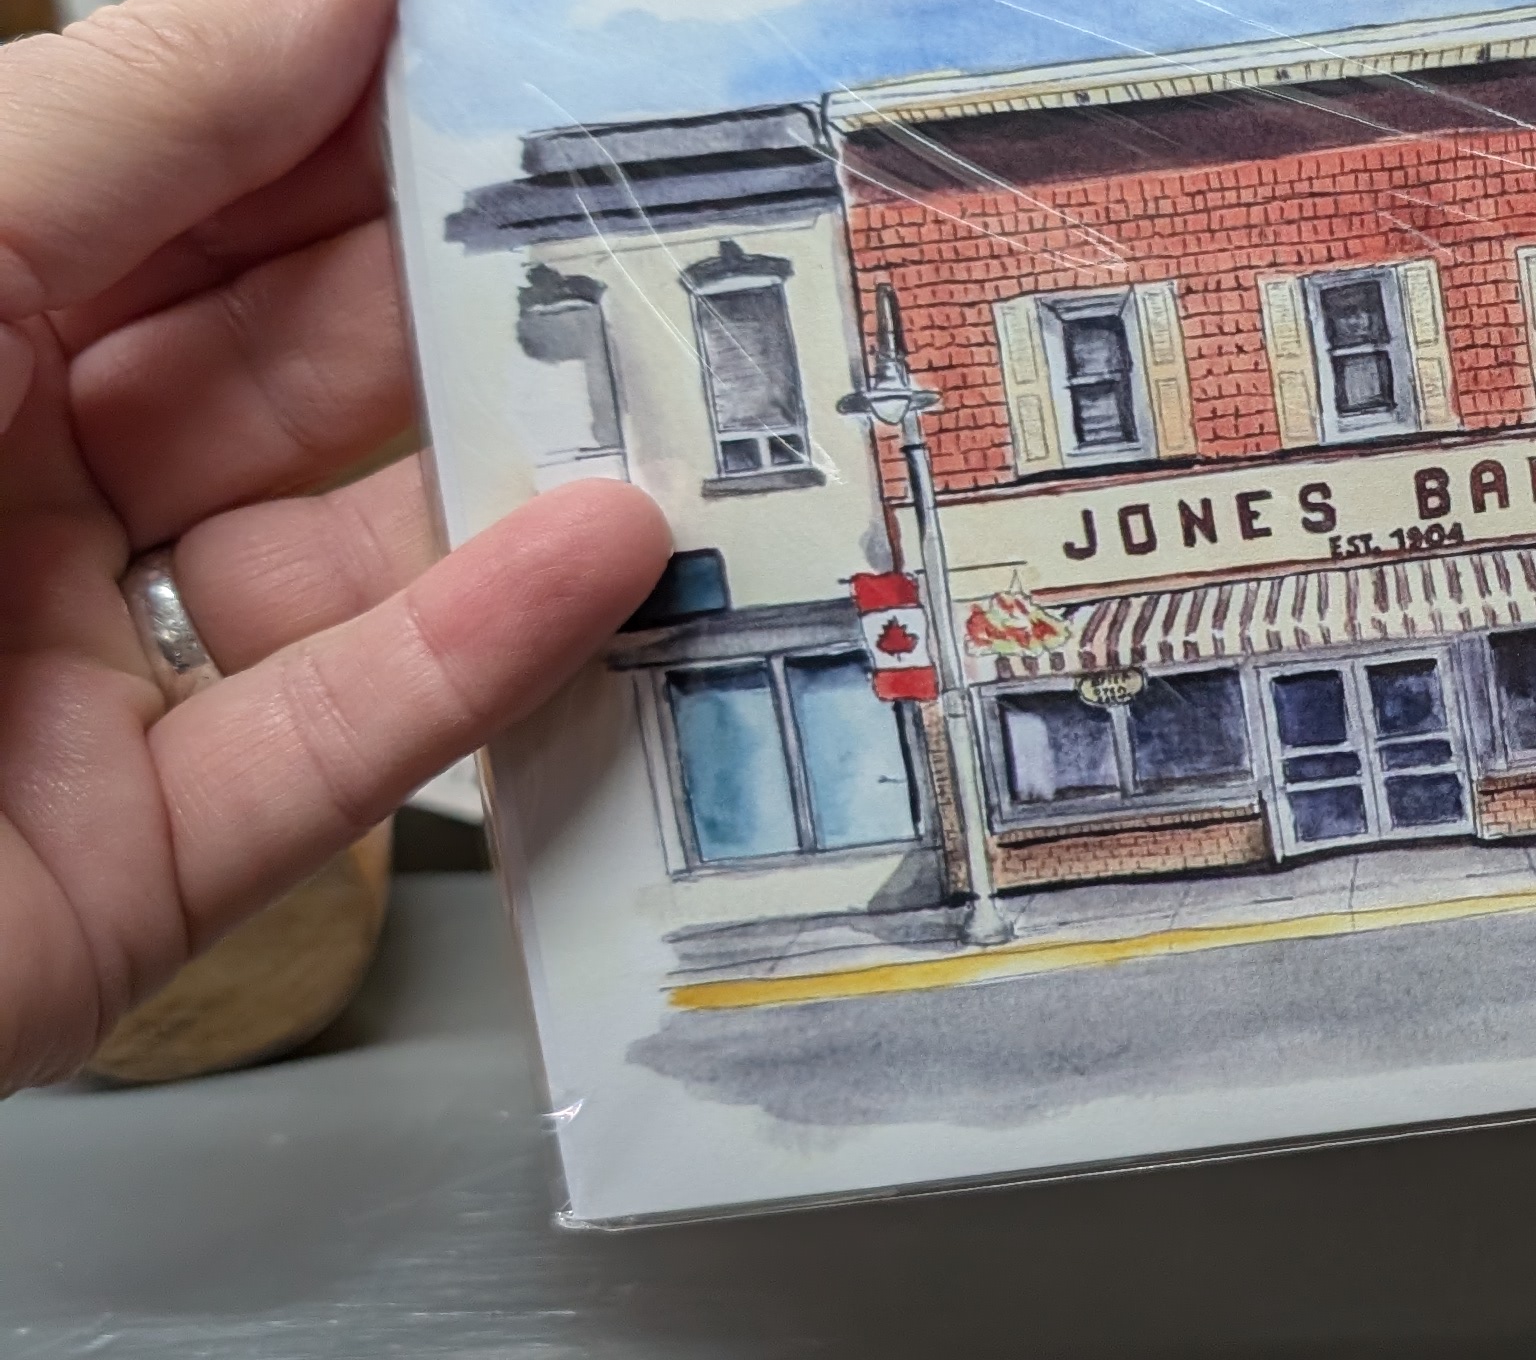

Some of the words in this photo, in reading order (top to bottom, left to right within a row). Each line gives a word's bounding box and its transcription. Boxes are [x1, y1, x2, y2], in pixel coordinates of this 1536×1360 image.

[1062, 481, 1337, 561] JONES
[1328, 531, 1382, 560] EST.
[1388, 521, 1465, 553] 1904
